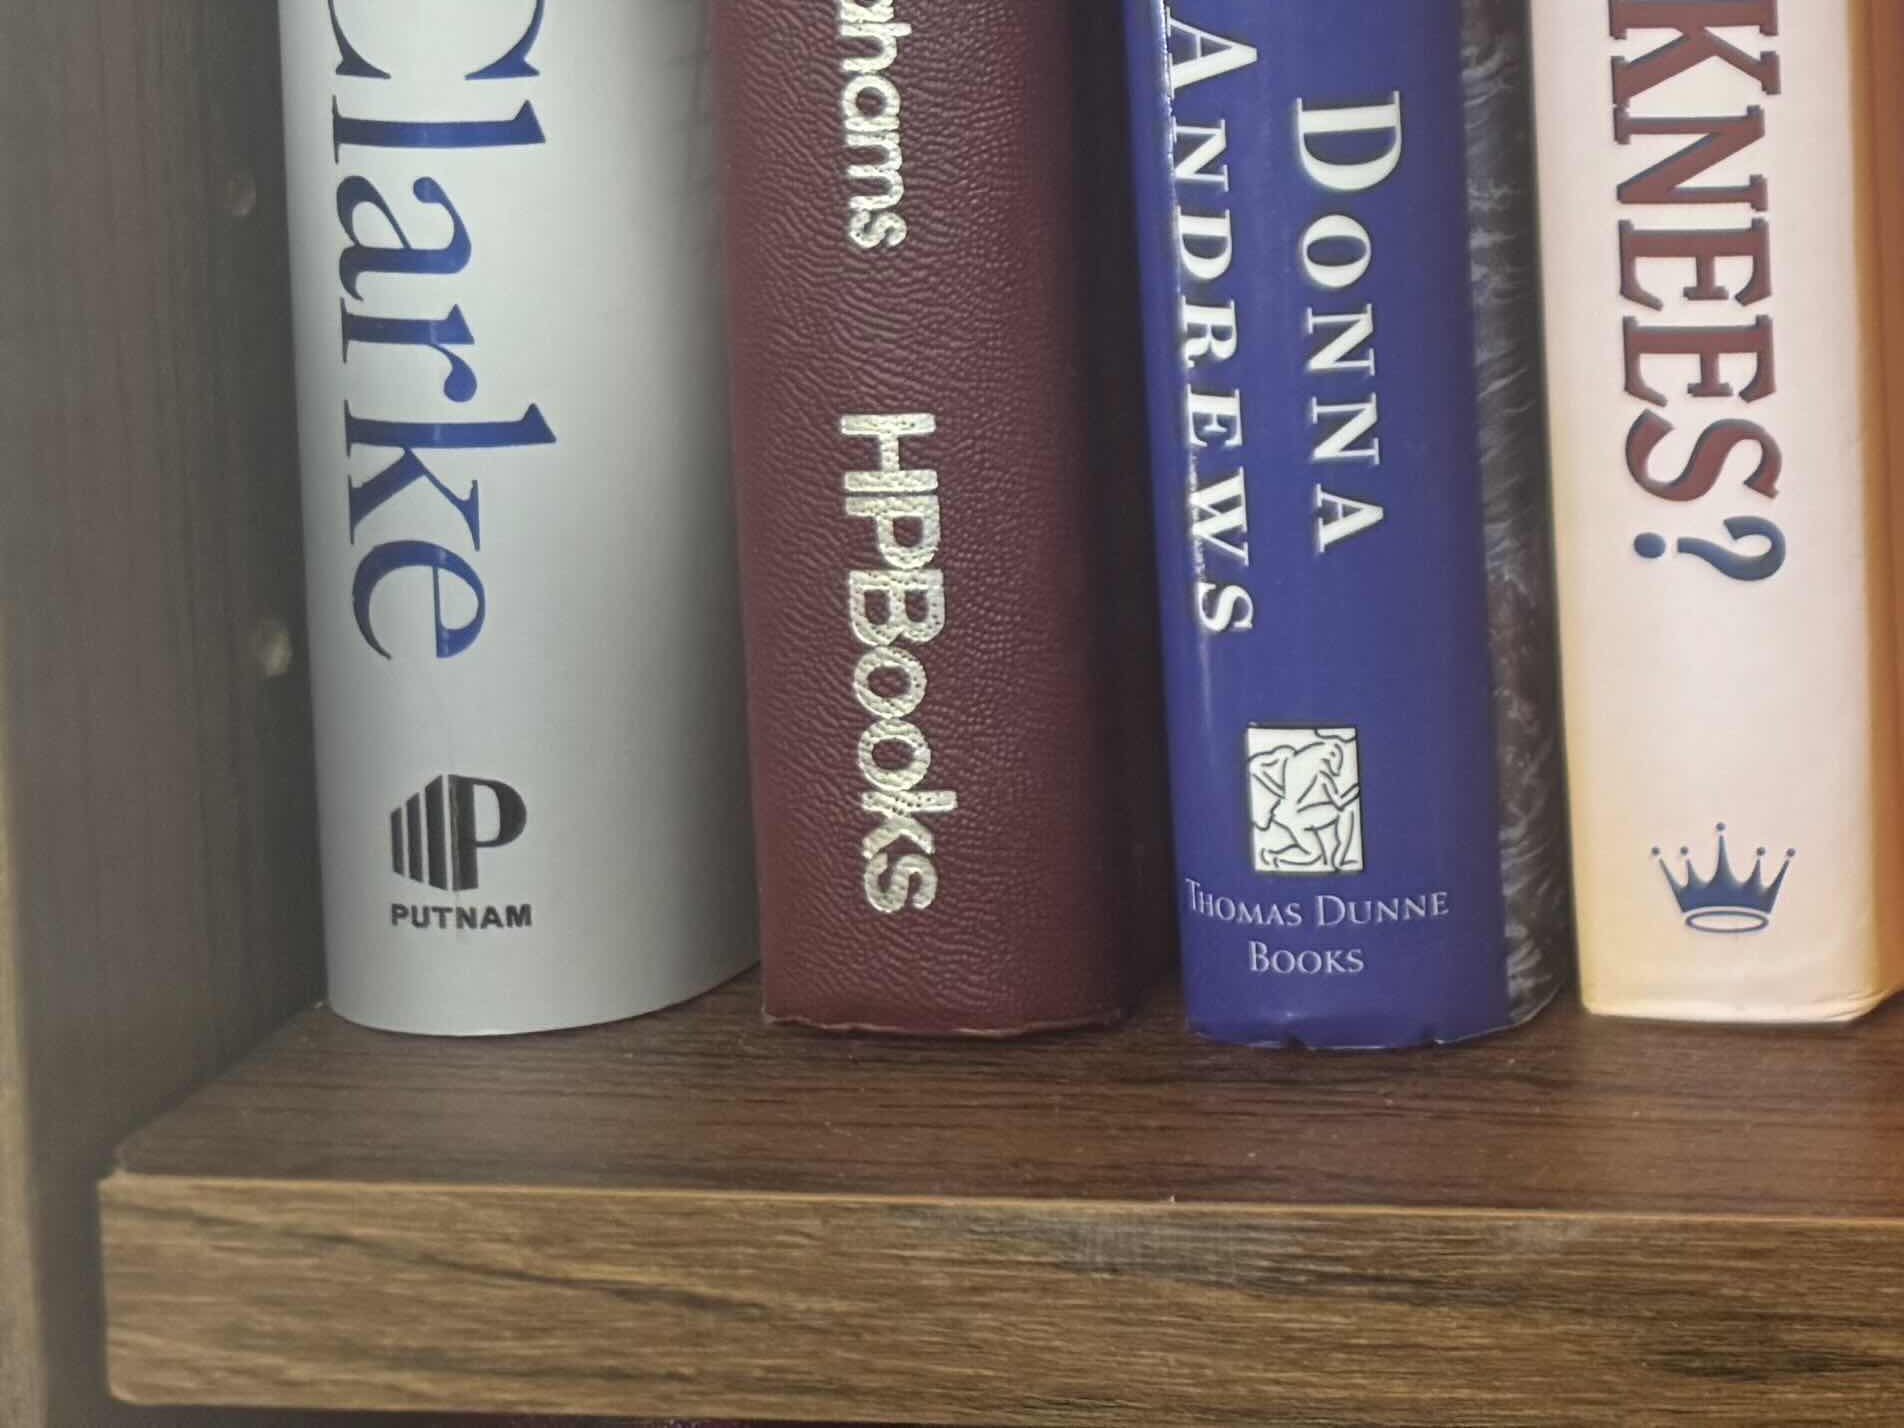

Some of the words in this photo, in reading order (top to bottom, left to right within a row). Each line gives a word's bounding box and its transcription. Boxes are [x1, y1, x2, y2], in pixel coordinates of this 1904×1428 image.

[1163, 9, 1260, 636] ANDREWS
[1293, 92, 1402, 554] DONNA
[838, 414, 957, 914] HPBooks
[391, 903, 532, 929] PUTNAM
[1185, 878, 1302, 926] THOMAS
[1315, 892, 1448, 926] DUNNE
[1249, 940, 1364, 973] BOOKS
